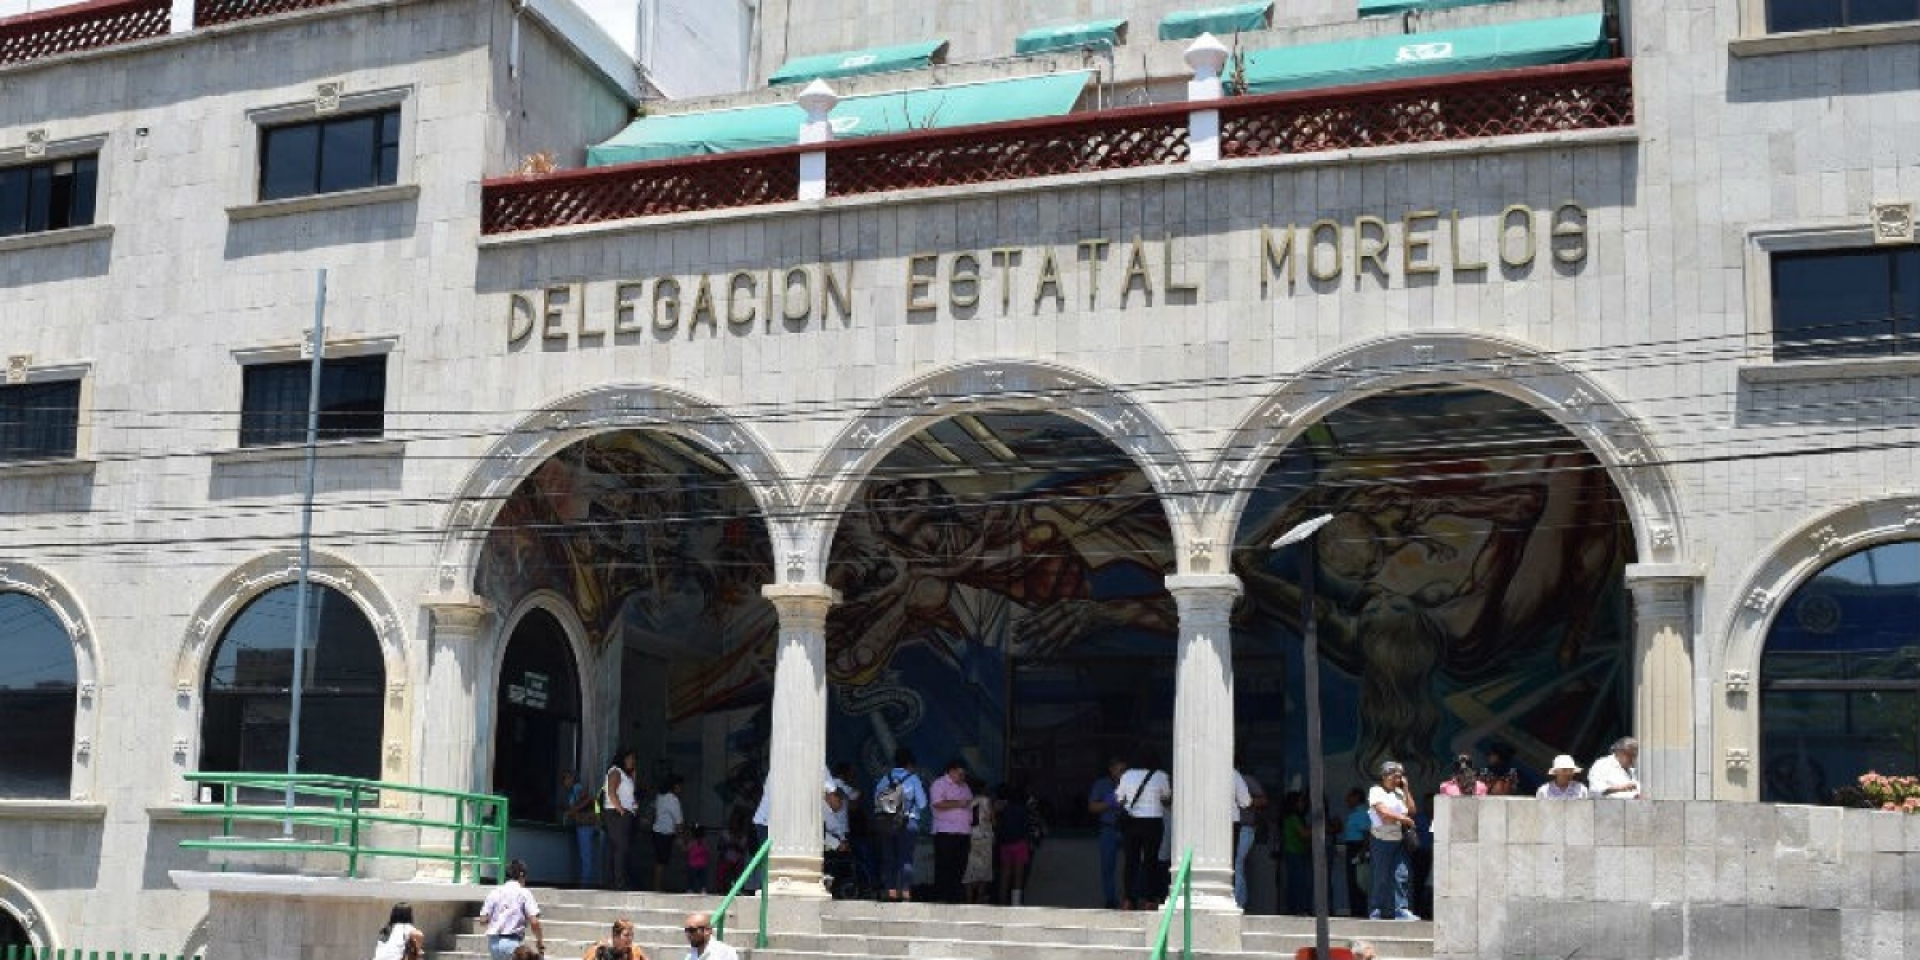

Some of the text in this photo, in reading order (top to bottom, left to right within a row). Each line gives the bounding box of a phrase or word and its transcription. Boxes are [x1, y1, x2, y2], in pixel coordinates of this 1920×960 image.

[508, 204, 1588, 343] DELEGACION ESTATAL MORELOS
